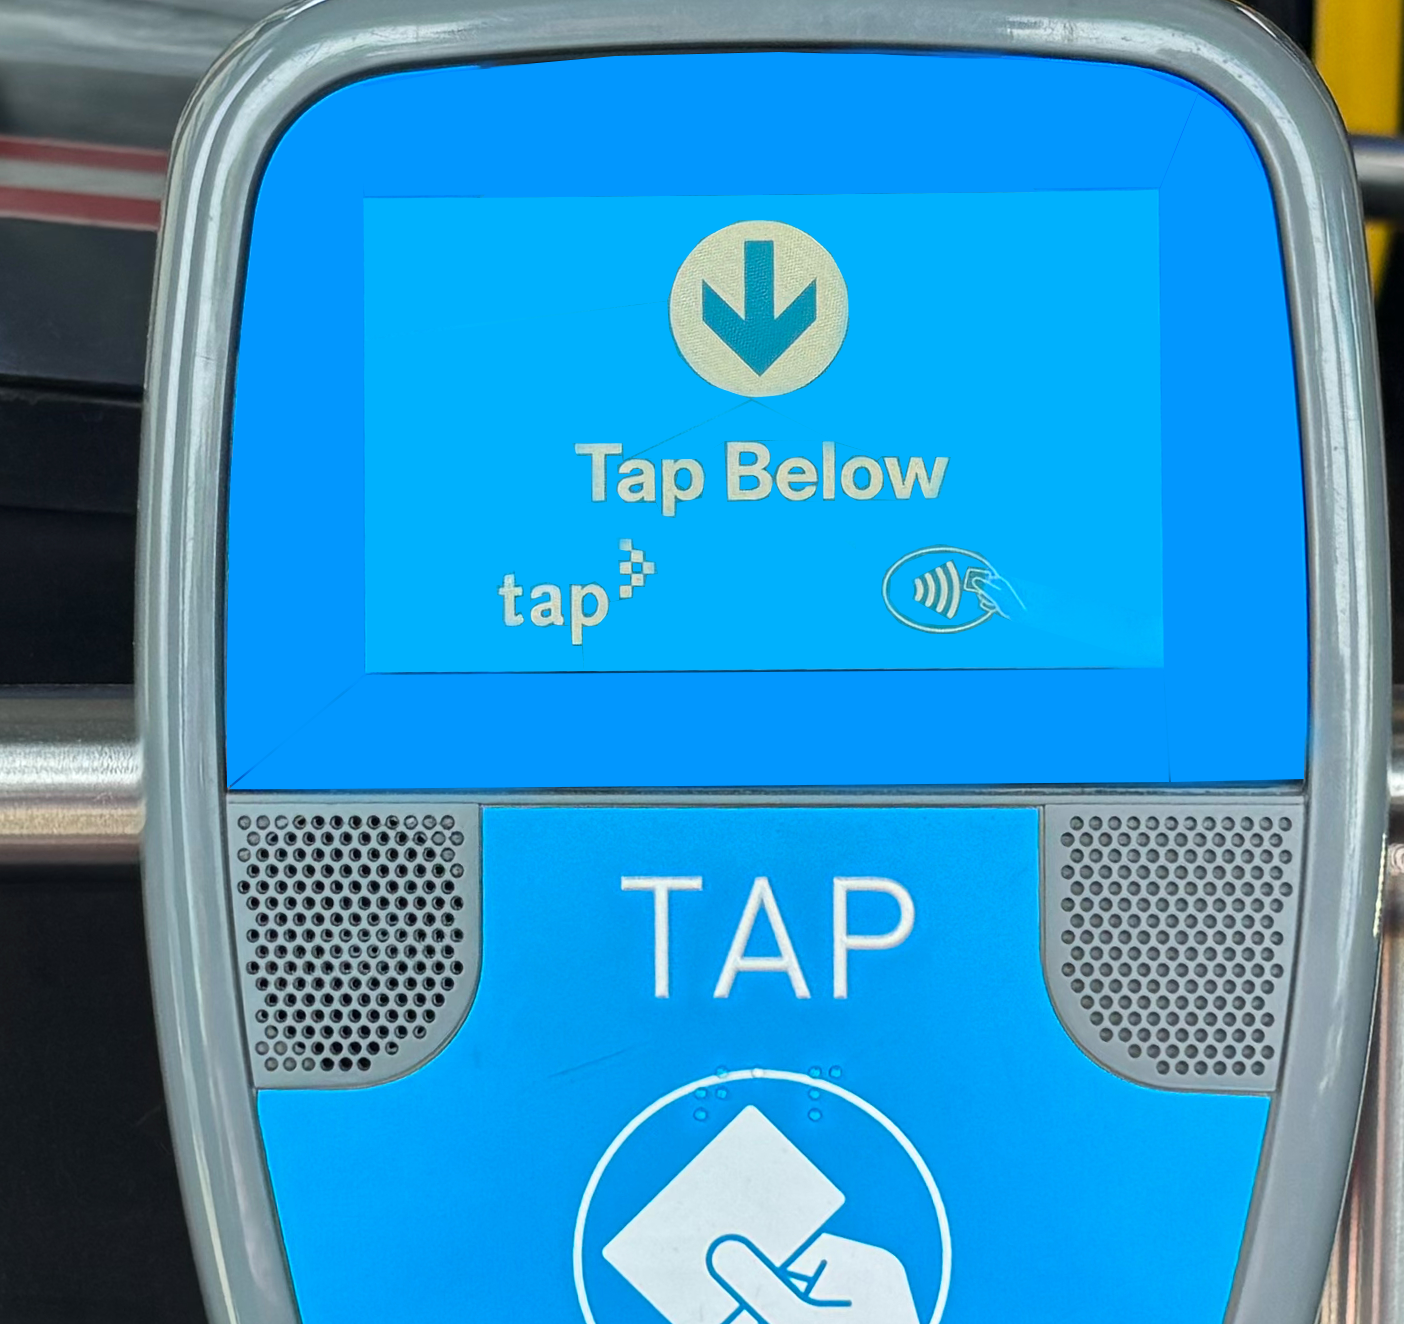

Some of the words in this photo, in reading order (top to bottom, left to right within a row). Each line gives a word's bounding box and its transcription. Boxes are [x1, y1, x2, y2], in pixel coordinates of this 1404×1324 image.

[573, 442, 705, 517] Tap
[725, 440, 951, 502] Below
[497, 572, 610, 646] tap
[620, 875, 916, 1000] TAP
